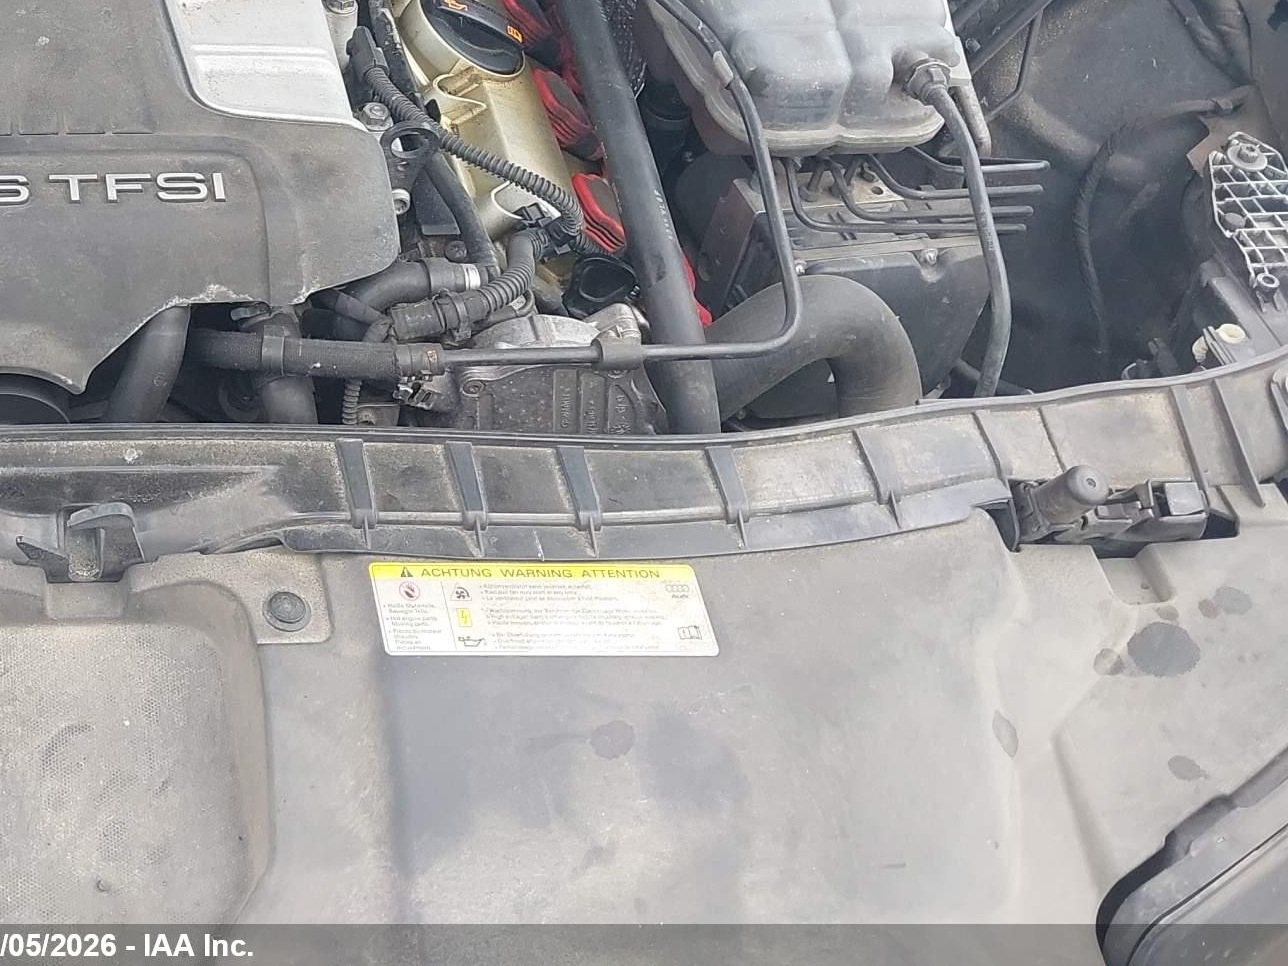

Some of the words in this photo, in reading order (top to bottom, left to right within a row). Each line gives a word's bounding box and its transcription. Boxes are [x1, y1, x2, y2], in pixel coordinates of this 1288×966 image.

[48, 172, 227, 205] TFSI
[420, 568, 493, 578] ACHTUNG
[500, 569, 573, 579] WARNING
[581, 569, 661, 579] ATTENTION
